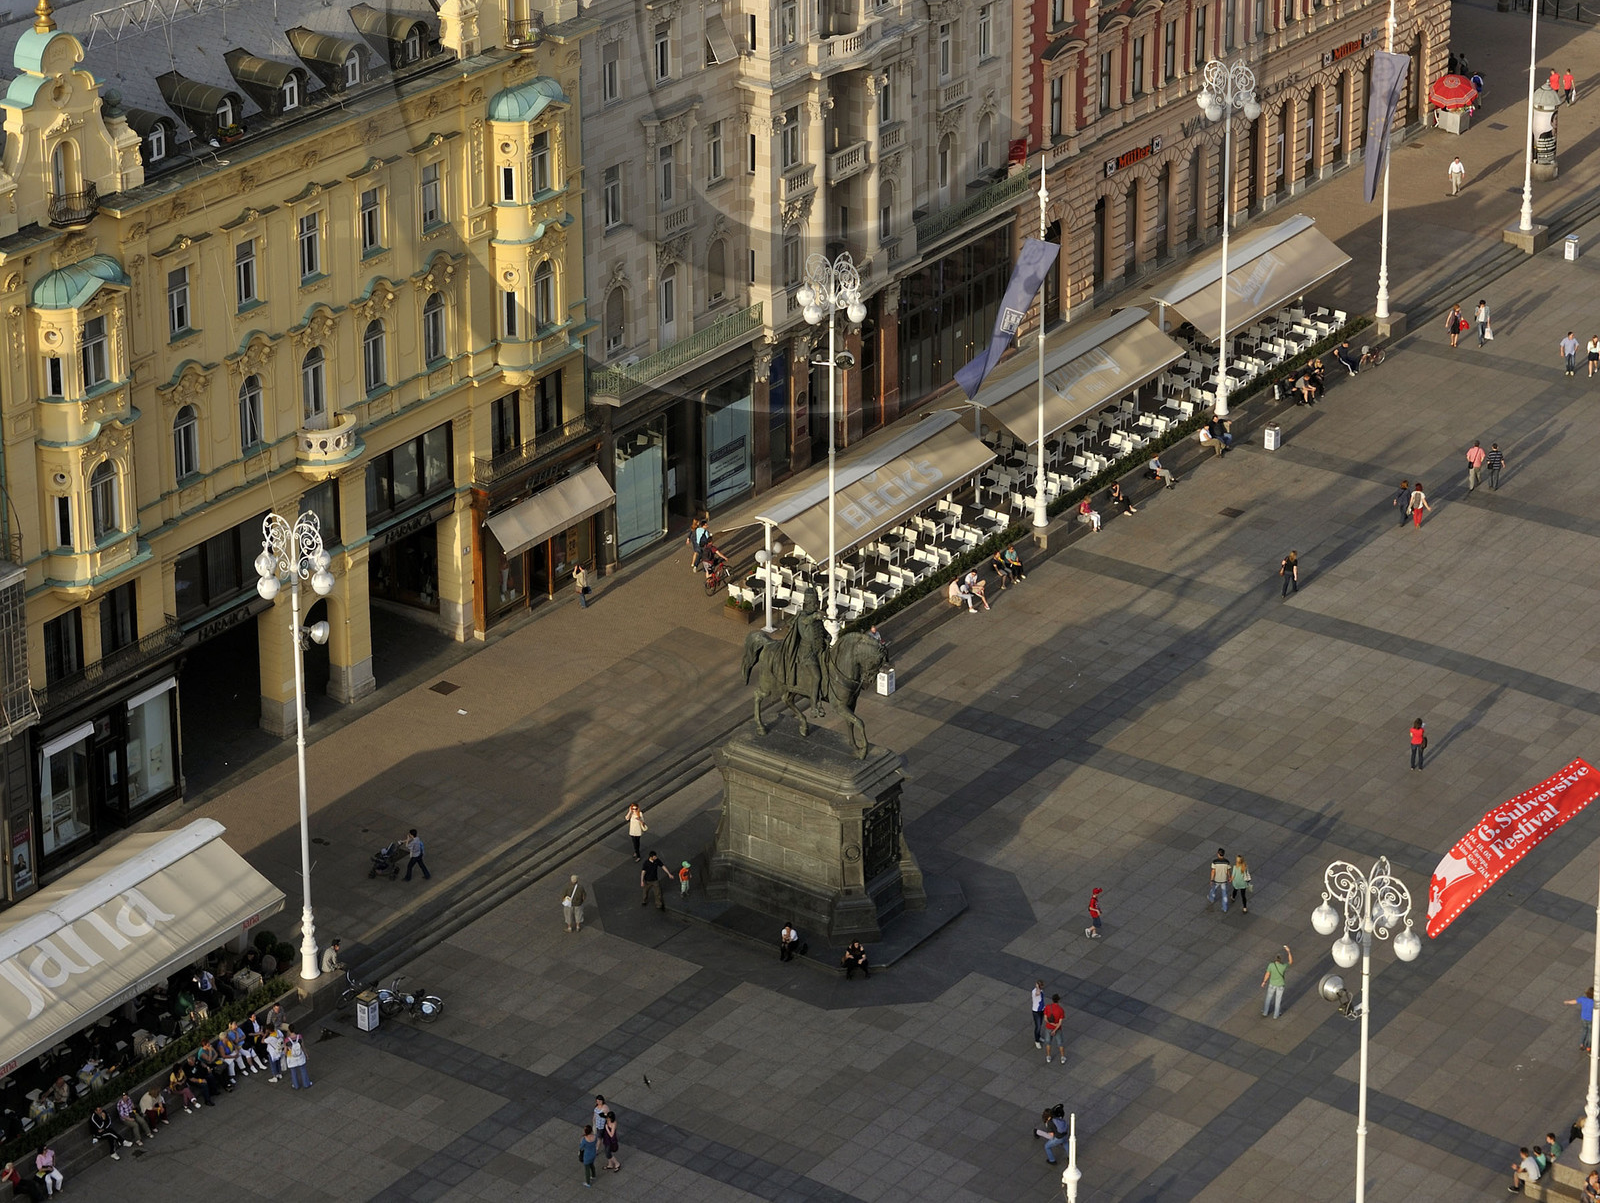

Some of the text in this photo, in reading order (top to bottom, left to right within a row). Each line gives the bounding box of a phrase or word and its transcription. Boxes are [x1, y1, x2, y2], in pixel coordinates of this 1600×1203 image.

[1117, 145, 1152, 170] Müller
[836, 459, 943, 530] BECK'S
[385, 513, 432, 544] HARMICA
[197, 605, 251, 642] HARMICA
[1494, 766, 1589, 829] Subversive
[1489, 801, 1561, 859] Festival
